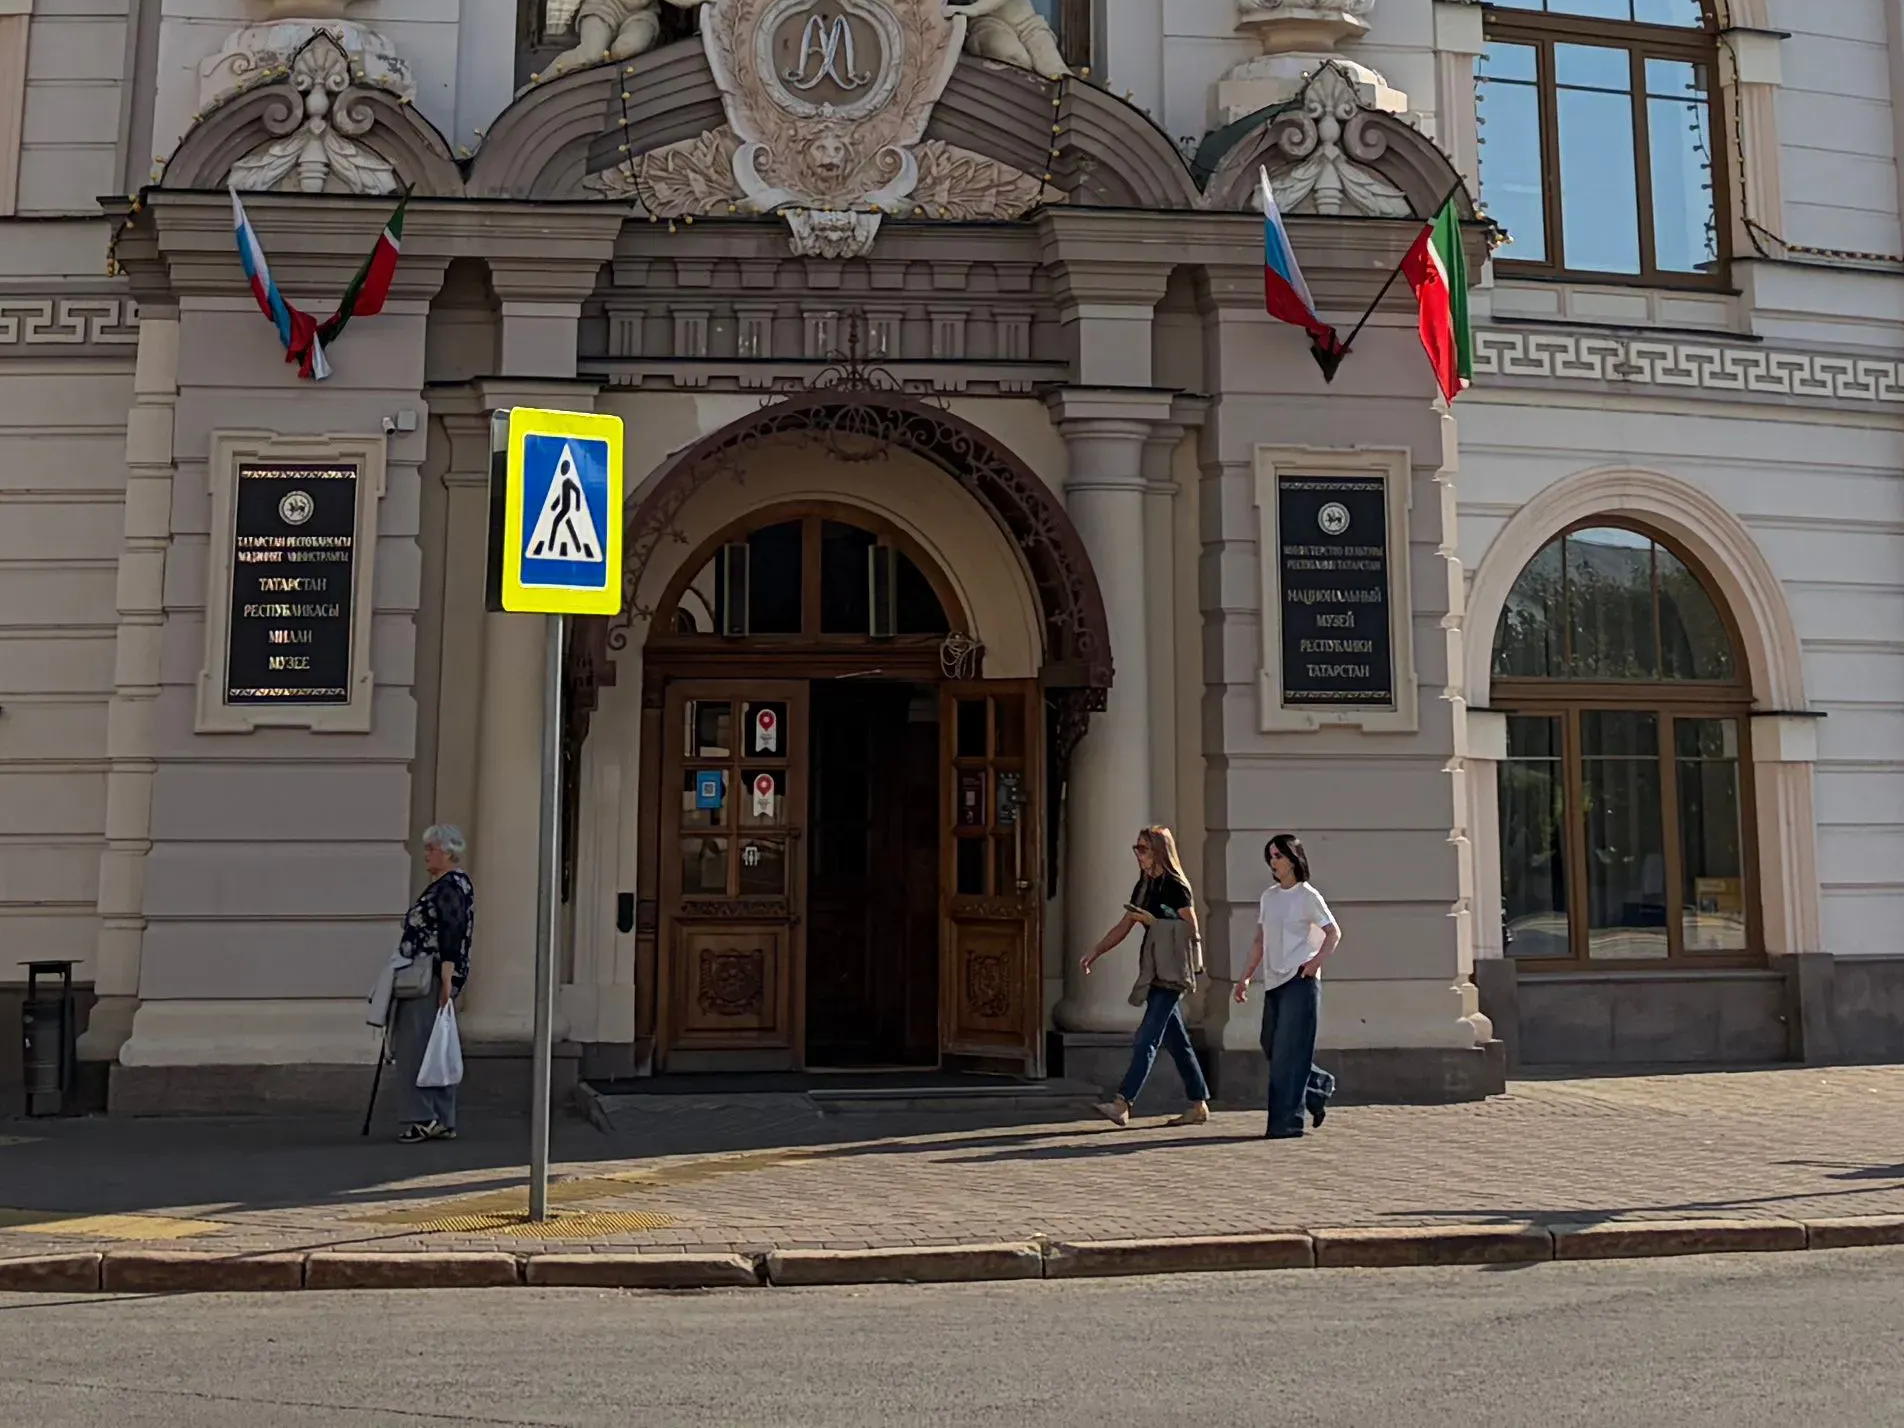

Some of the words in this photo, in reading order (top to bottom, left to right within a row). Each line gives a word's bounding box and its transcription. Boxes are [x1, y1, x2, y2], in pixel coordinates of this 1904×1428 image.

[258, 577, 327, 591] ТАТАРСТАН
[1287, 587, 1382, 605] НАЦИОНАЛЬНЫЙ
[243, 604, 339, 617] РЕСПУБЛИКАСЫ
[1316, 611, 1355, 627] МУЗЕЙ
[268, 630, 312, 643] МИЛЛИ
[1300, 639, 1373, 653] РЕСПУБЛИКИ
[268, 656, 310, 670] МУЗЕЕ
[1306, 664, 1370, 677] ТАТАРСТАН
